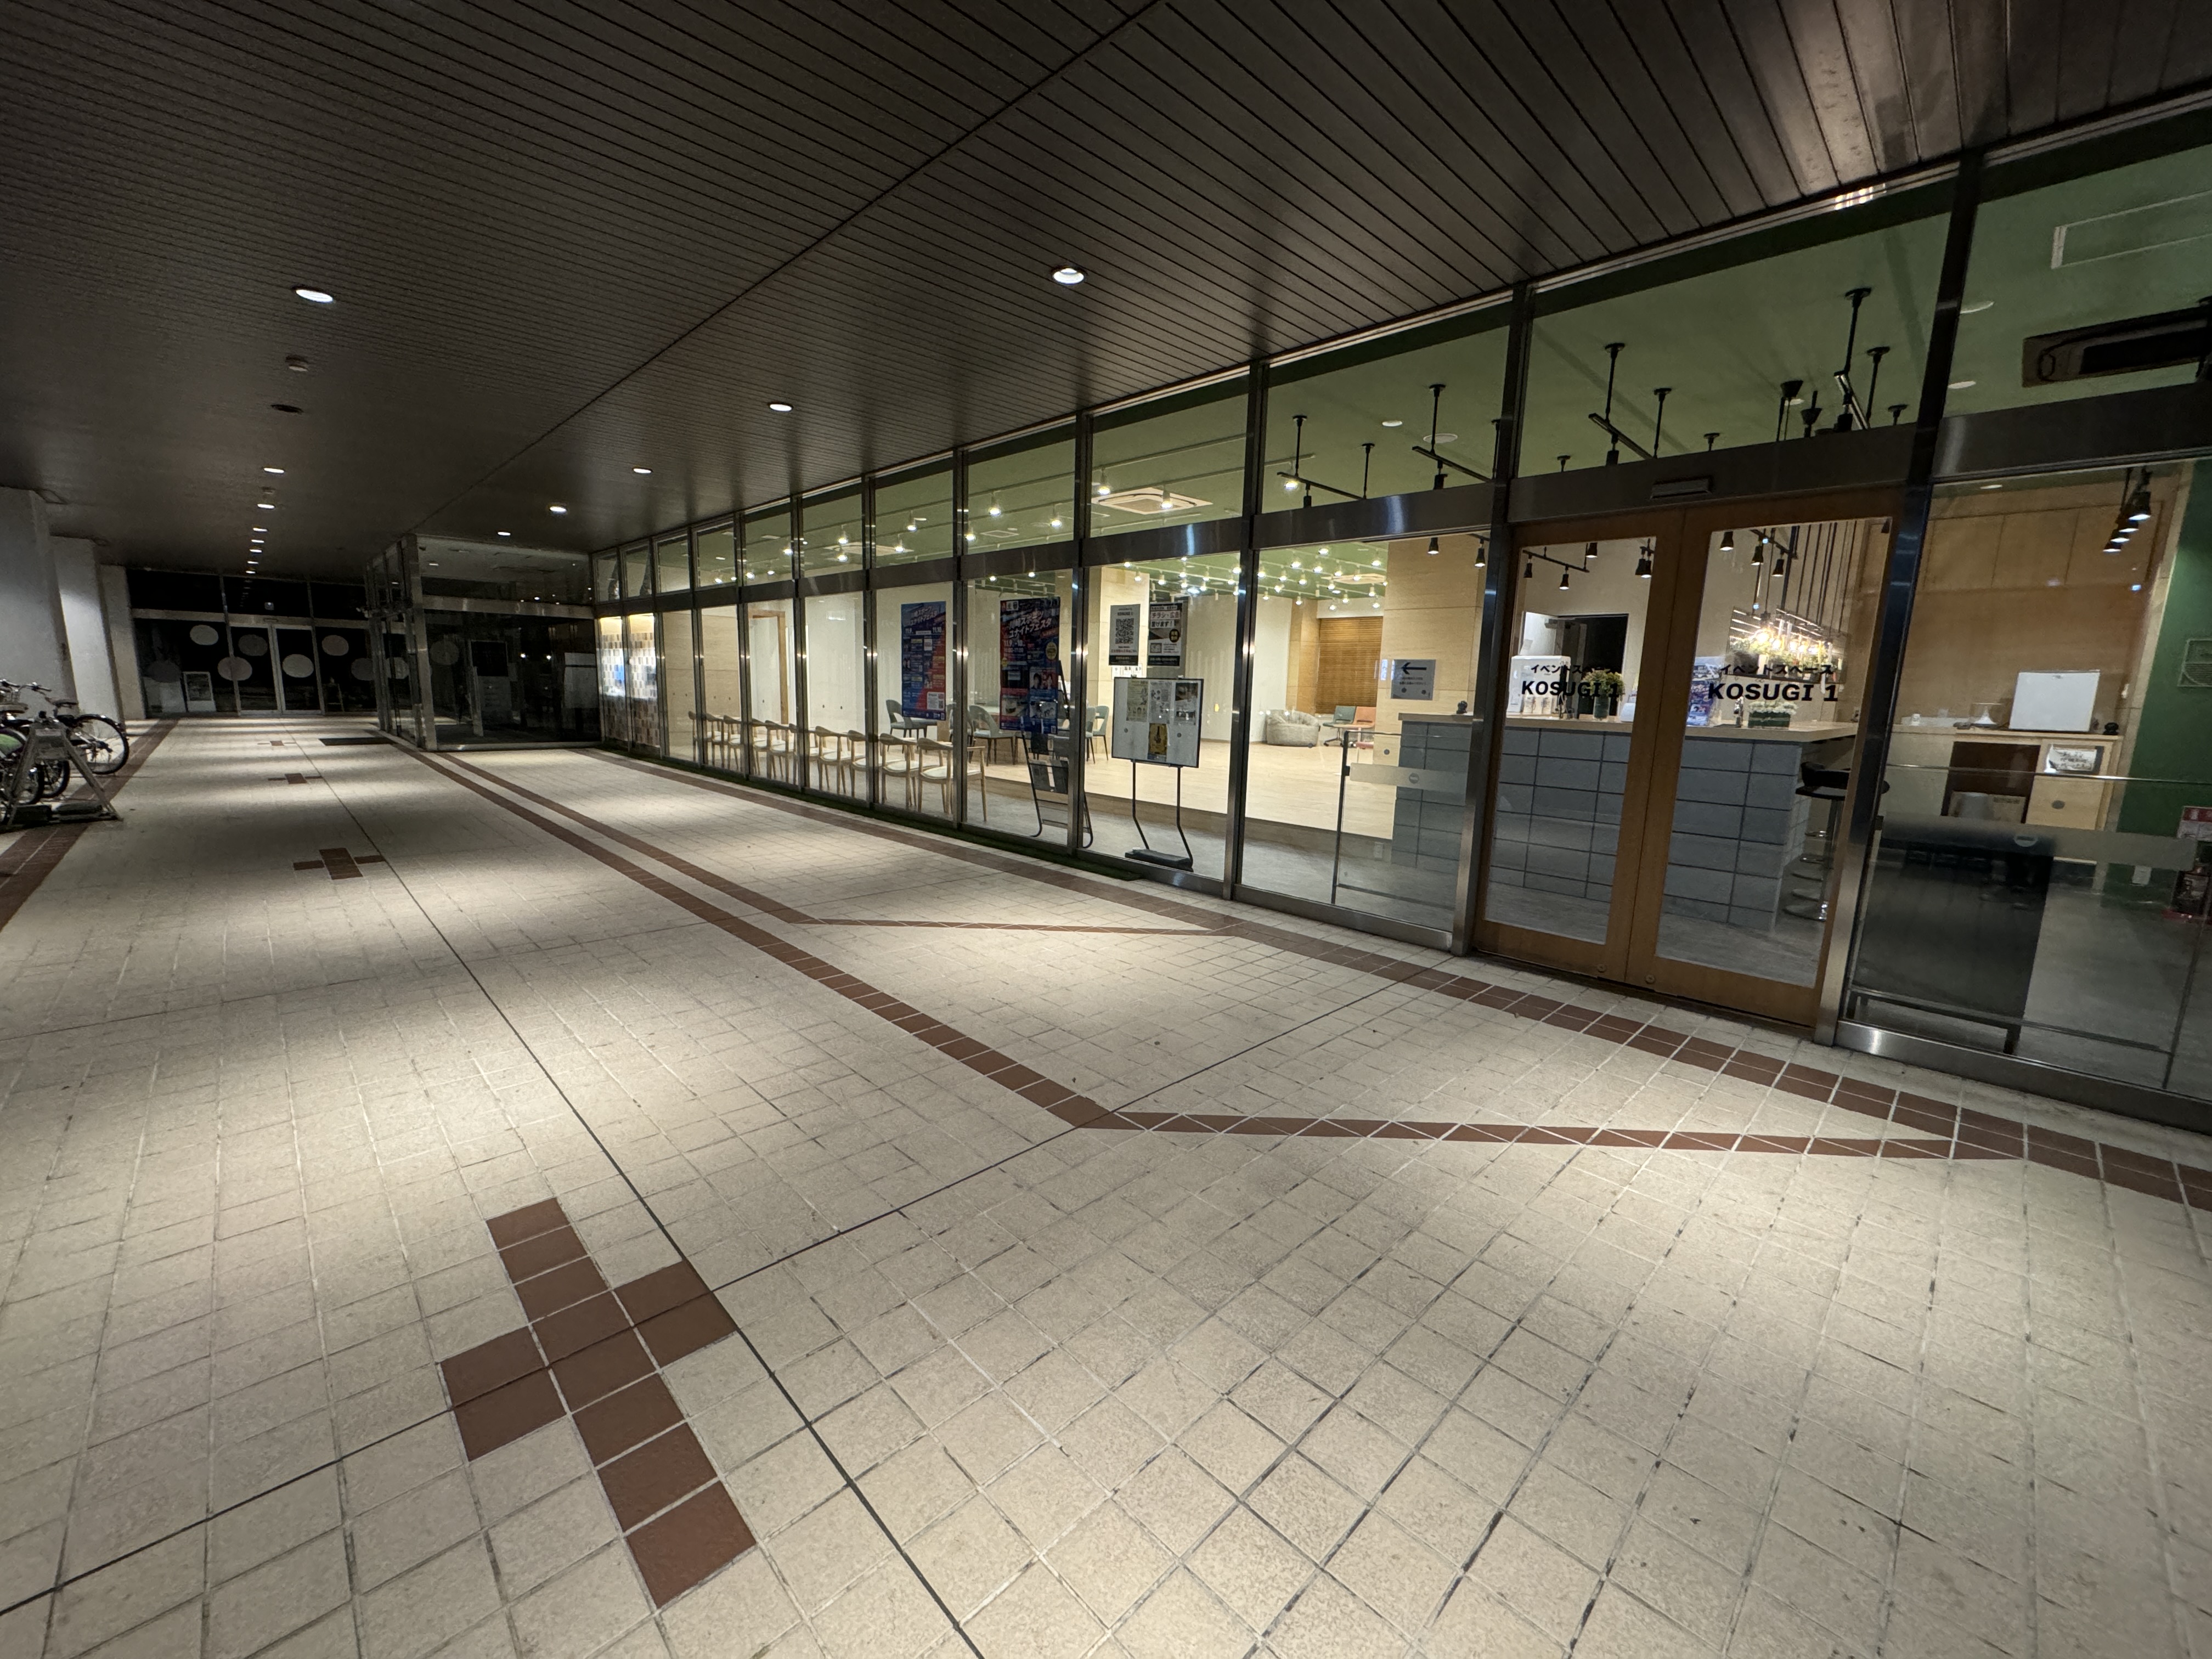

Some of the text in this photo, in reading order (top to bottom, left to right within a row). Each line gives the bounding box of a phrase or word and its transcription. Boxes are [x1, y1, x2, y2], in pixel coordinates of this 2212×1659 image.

[1008, 618, 1052, 639] ユナイトフェスタ
[1720, 664, 1833, 675] イベントスペース
[1521, 681, 1619, 697] KOSUGI 1
[1708, 682, 1814, 701] KOSUGI
[1824, 685, 1838, 701] 1
